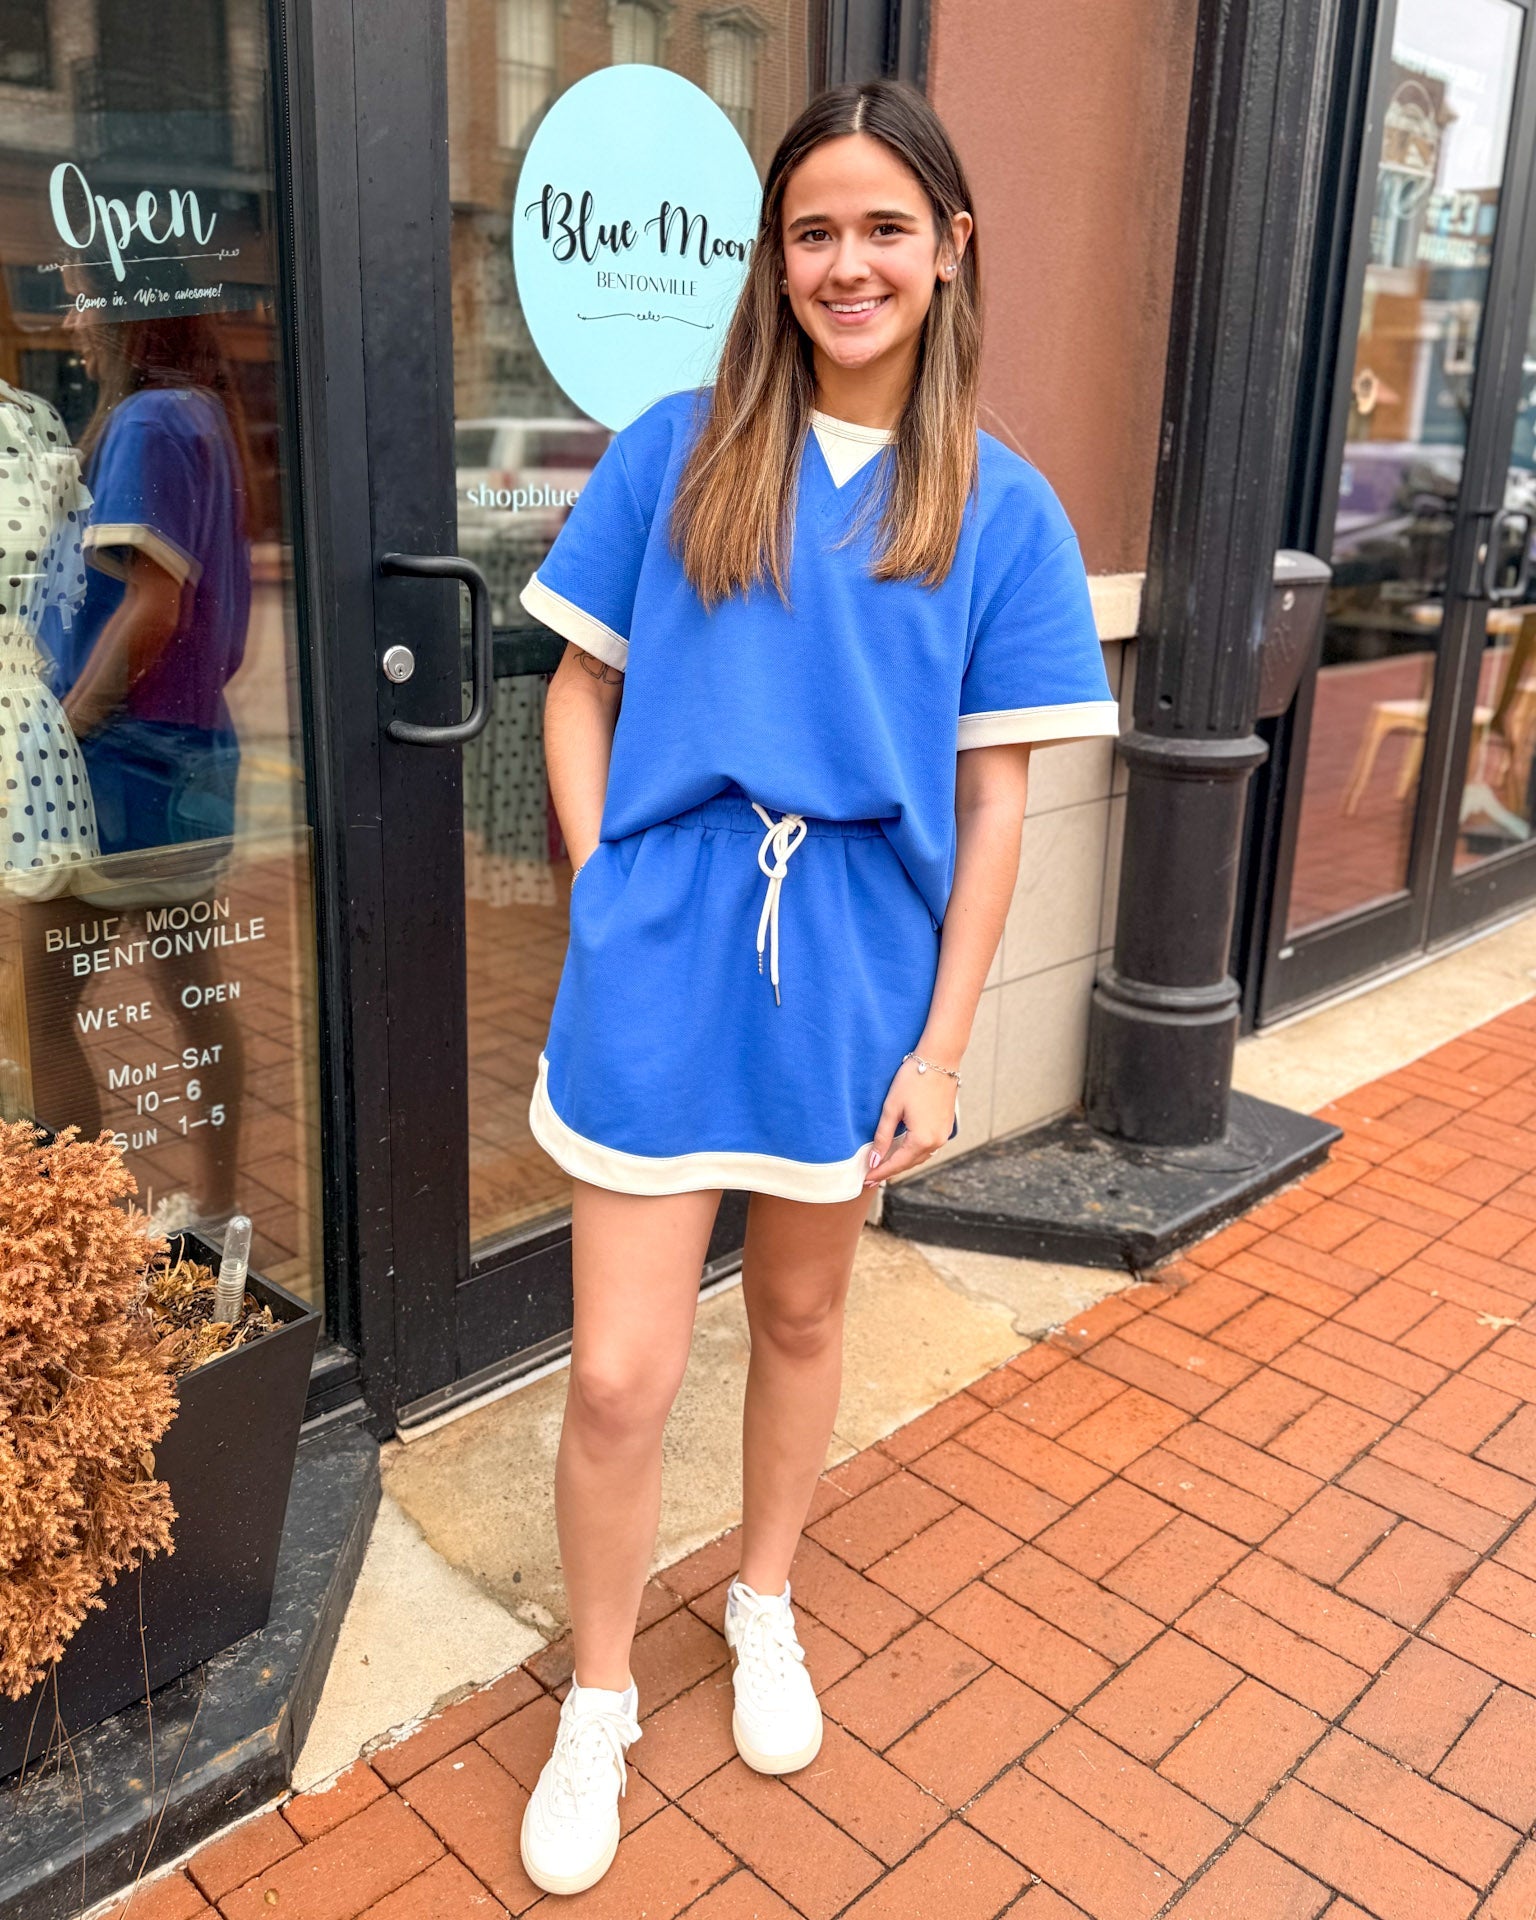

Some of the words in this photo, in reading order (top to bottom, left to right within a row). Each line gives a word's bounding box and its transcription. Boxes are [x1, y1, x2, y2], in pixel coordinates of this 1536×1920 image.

[49, 162, 217, 282] Open
[524, 184, 638, 263] Blue
[75, 292, 108, 313] Come
[112, 290, 128, 306] in.
[133, 287, 170, 307] We're
[174, 282, 223, 301] awesome!
[596, 271, 699, 297] BENTONVILLE
[45, 918, 121, 953] BLUE
[146, 897, 231, 934] MOON
[72, 917, 266, 978] BENTONVILLE
